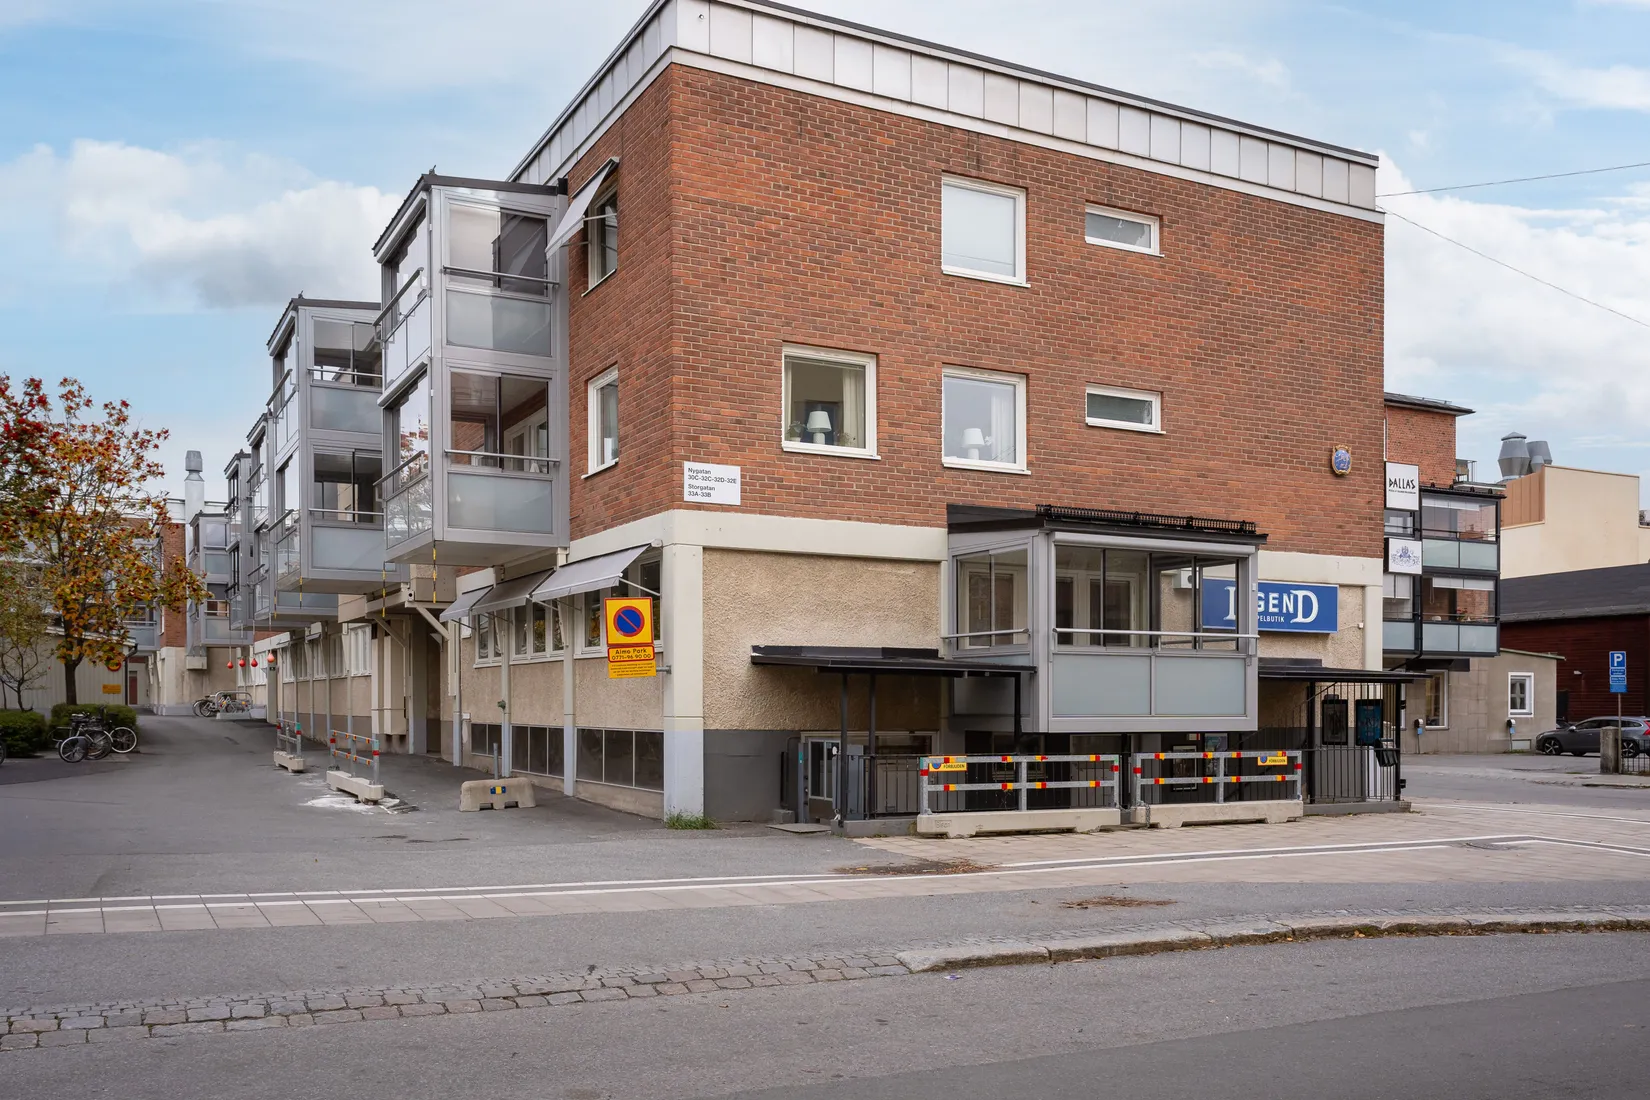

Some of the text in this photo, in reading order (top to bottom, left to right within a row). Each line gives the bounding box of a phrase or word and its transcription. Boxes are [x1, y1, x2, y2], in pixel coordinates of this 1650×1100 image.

[688, 467, 711, 475] Nygatan
[688, 483, 716, 491] Storgatan
[1388, 477, 1416, 490] DALLAS
[688, 490, 712, 498] 33A-33B
[1223, 585, 1319, 624] LGEND
[1257, 615, 1285, 623] PELBUTIK
[1613, 653, 1623, 667] P
